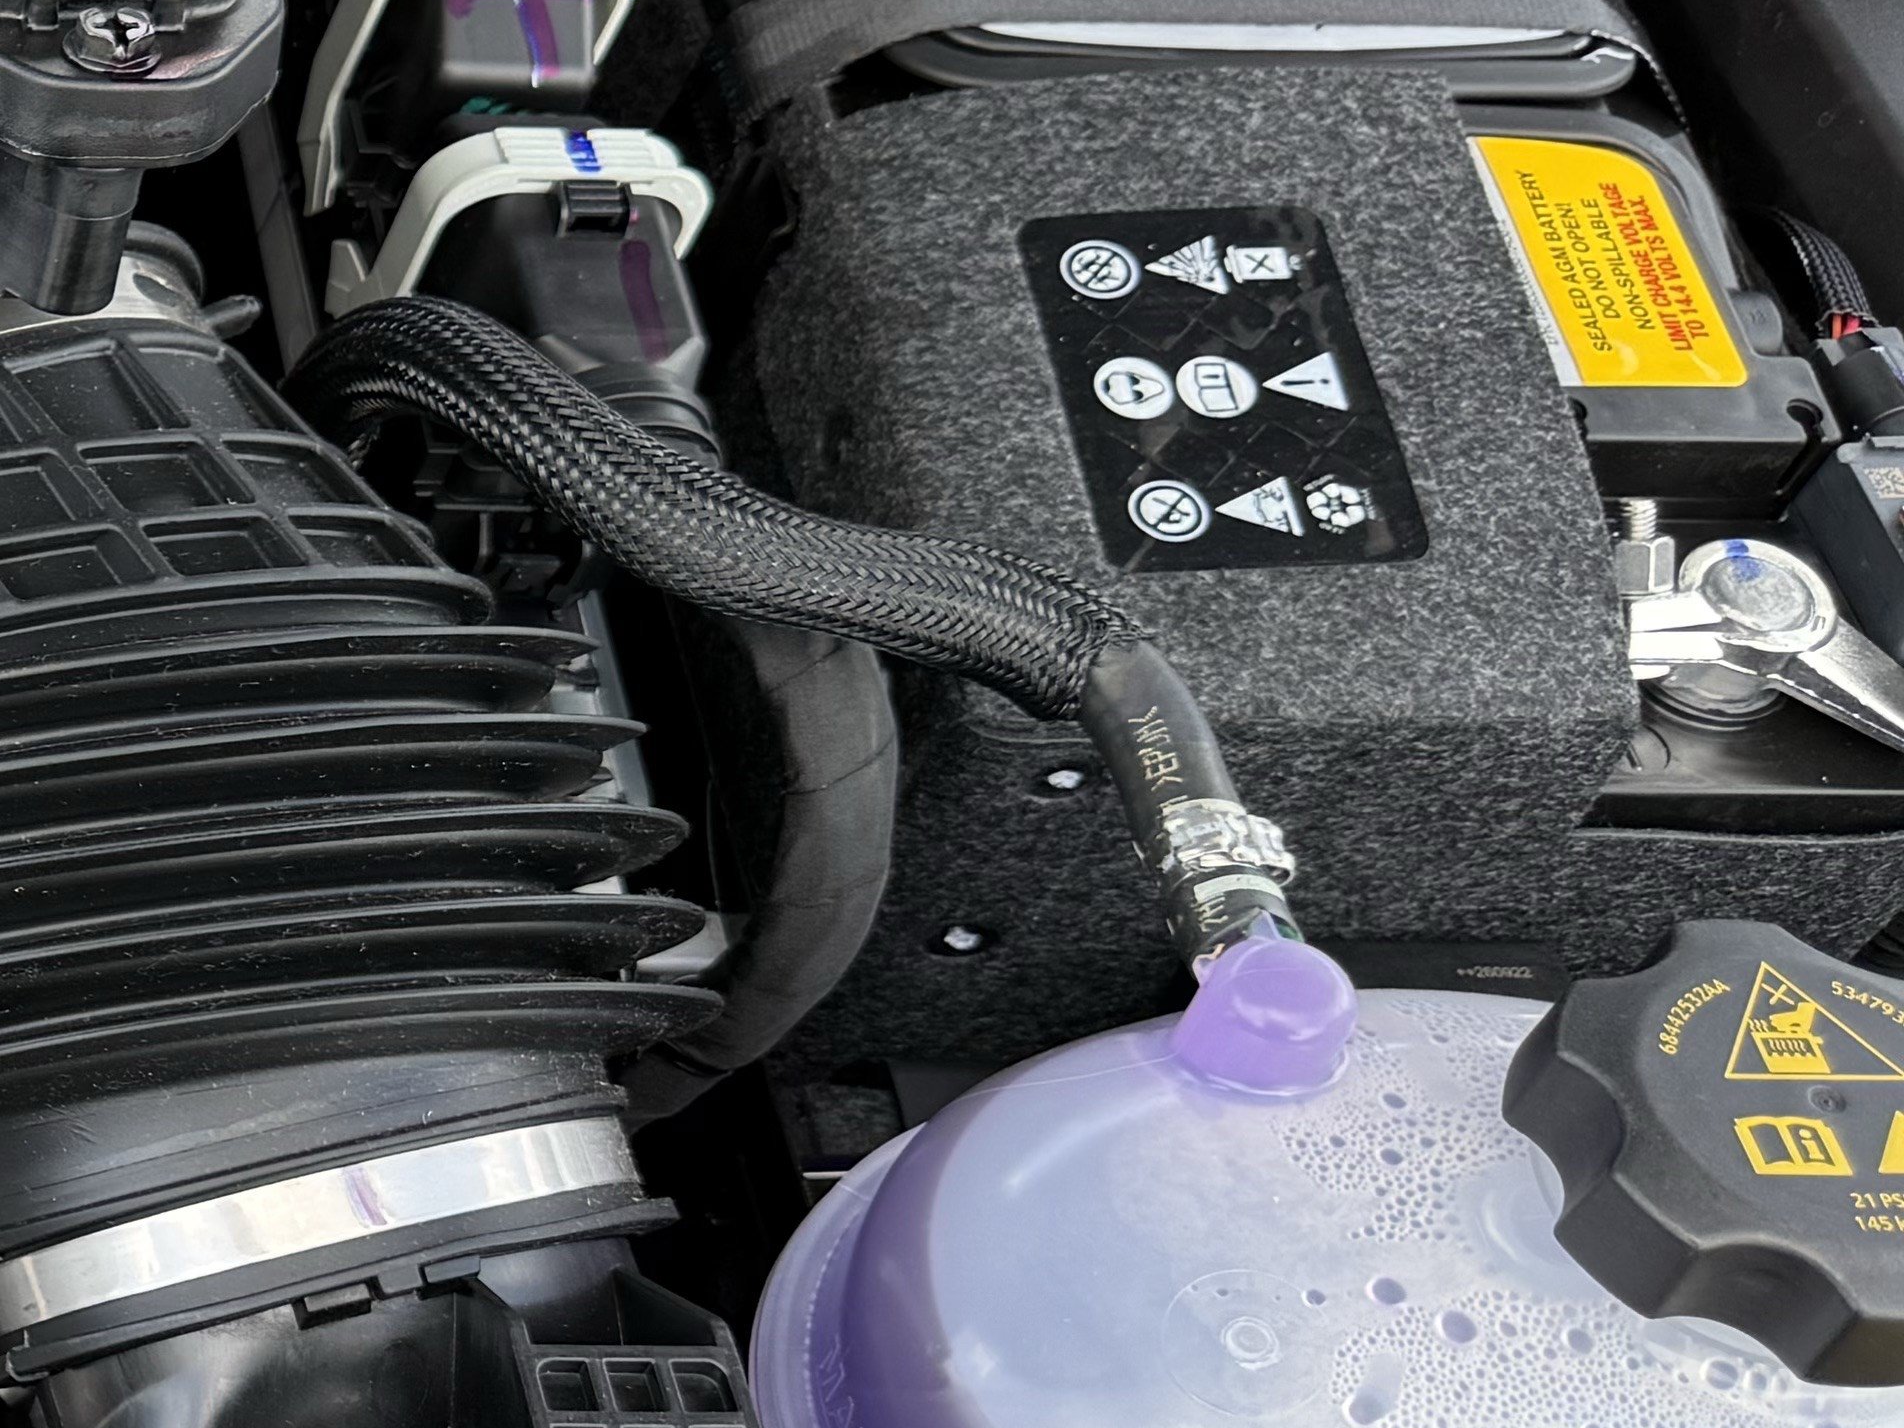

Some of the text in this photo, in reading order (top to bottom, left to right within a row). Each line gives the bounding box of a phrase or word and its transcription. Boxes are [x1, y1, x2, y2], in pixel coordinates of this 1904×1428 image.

[1515, 170, 1561, 243] BATTERY
[1549, 246, 1581, 284] AGM
[1555, 202, 1621, 320] DO NOT OPEN!
[1580, 197, 1656, 331] NON-SPILLABLE
[1599, 182, 1693, 352] LIMIT CHARGE VOLTAGE
[1646, 235, 1682, 283] VOLTS
[1568, 287, 1613, 352] SEALED
[1673, 284, 1699, 315] 14.4
[1685, 318, 1710, 339] TO
[1657, 978, 1731, 1056] 68442532AA
[1850, 1192, 1876, 1209] 21
[1854, 1215, 1891, 1232] 145
